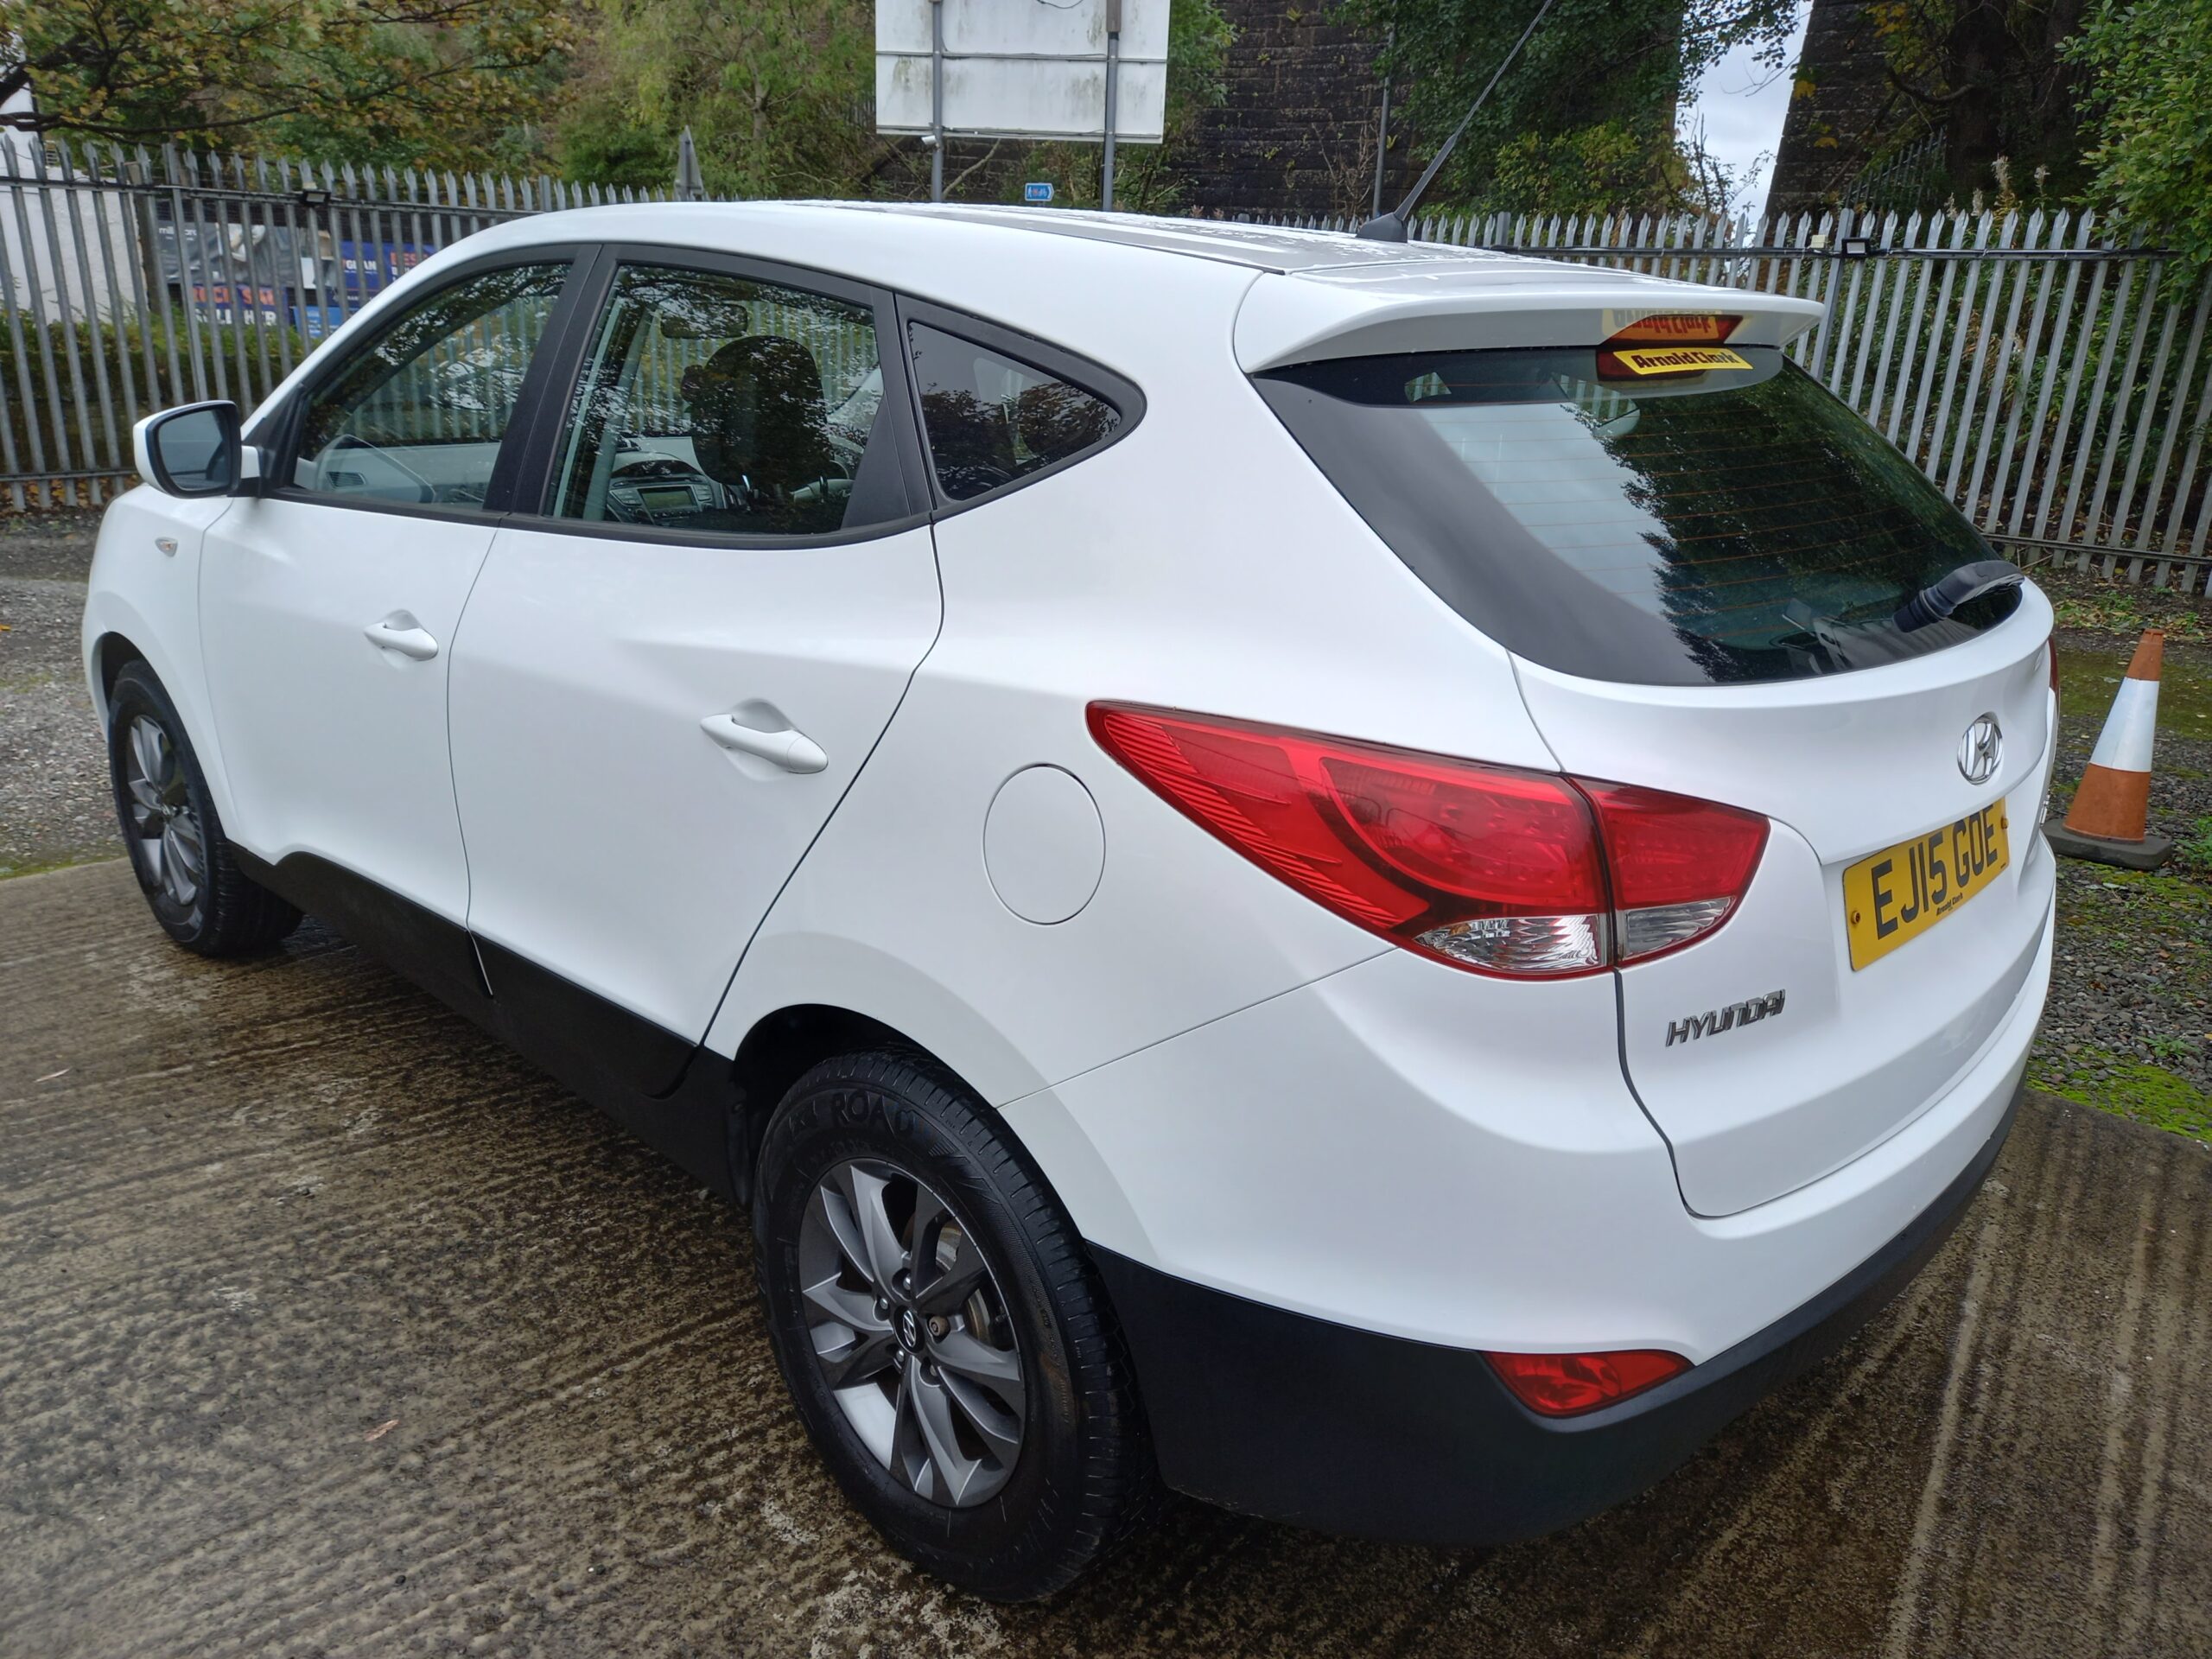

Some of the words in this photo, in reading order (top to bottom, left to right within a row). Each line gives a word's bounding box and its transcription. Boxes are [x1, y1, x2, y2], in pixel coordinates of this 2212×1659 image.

[1630, 352, 1699, 368] Arnold
[1690, 352, 1740, 364] Clark
[1871, 830, 1948, 940] EJ15
[1952, 804, 1998, 888] GOE
[1665, 988, 1786, 1047] HYUNDAI
